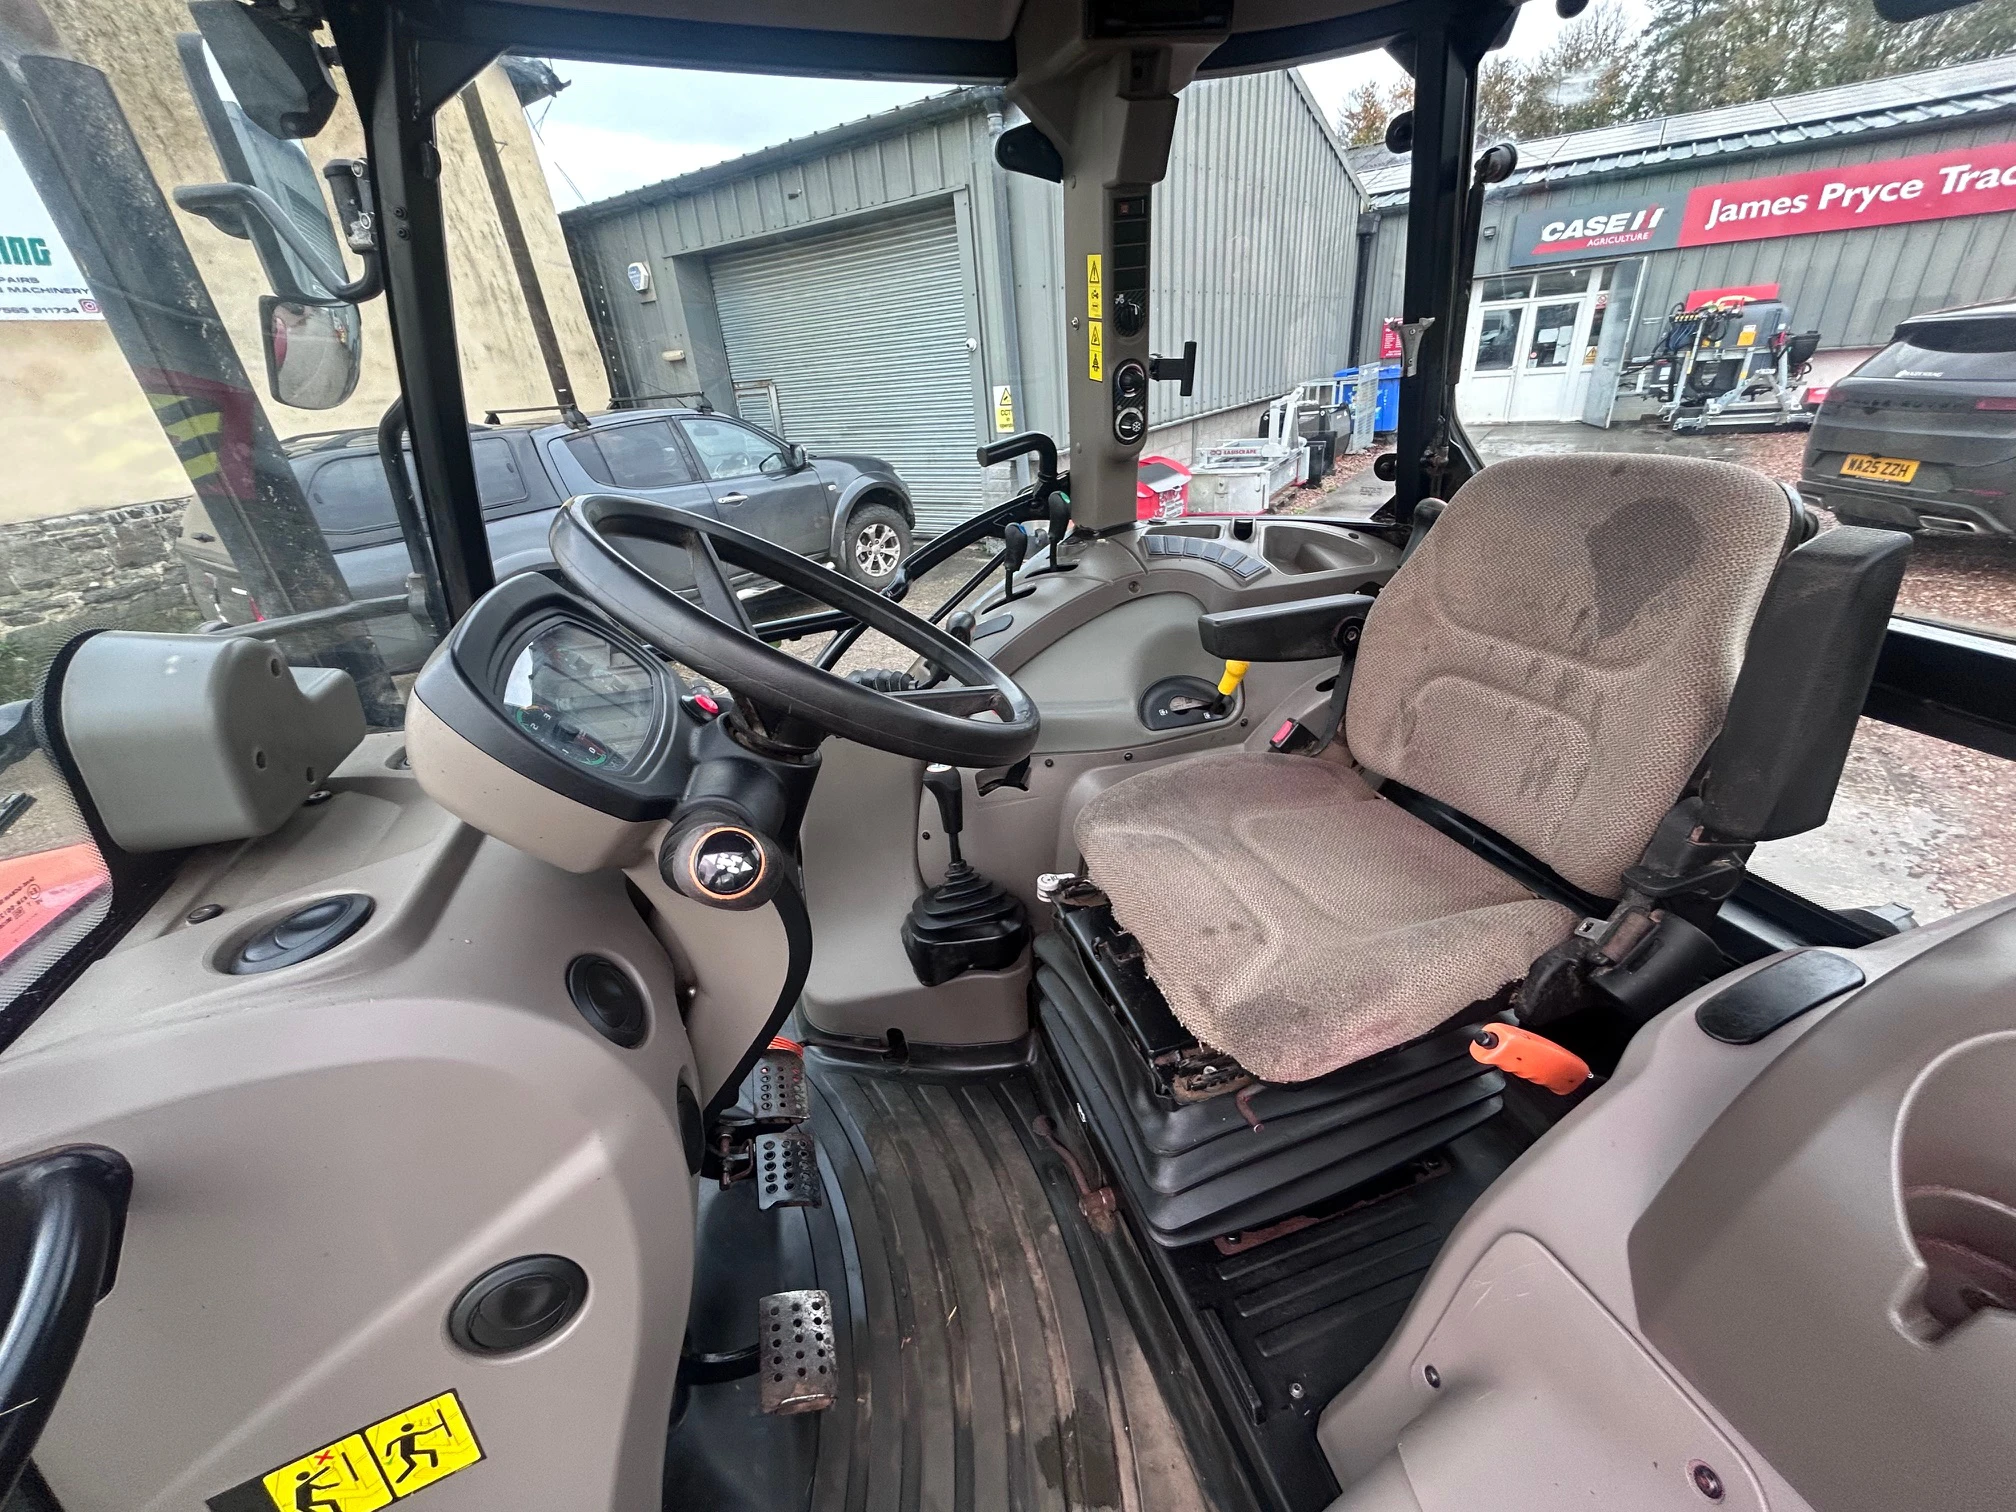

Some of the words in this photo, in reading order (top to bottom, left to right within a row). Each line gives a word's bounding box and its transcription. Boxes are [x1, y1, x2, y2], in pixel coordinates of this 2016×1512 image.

[1704, 193, 1809, 231] James
[1817, 177, 1924, 214] Pryce
[1938, 163, 2016, 195] Trac
[1541, 212, 1632, 242] CASE
[1586, 231, 1650, 247] AGRICULTURE
[7, 286, 89, 294] MACHINERY
[1847, 458, 1881, 474] WA25
[1880, 462, 1911, 478] ZZH
[529, 722, 539, 731] 2
